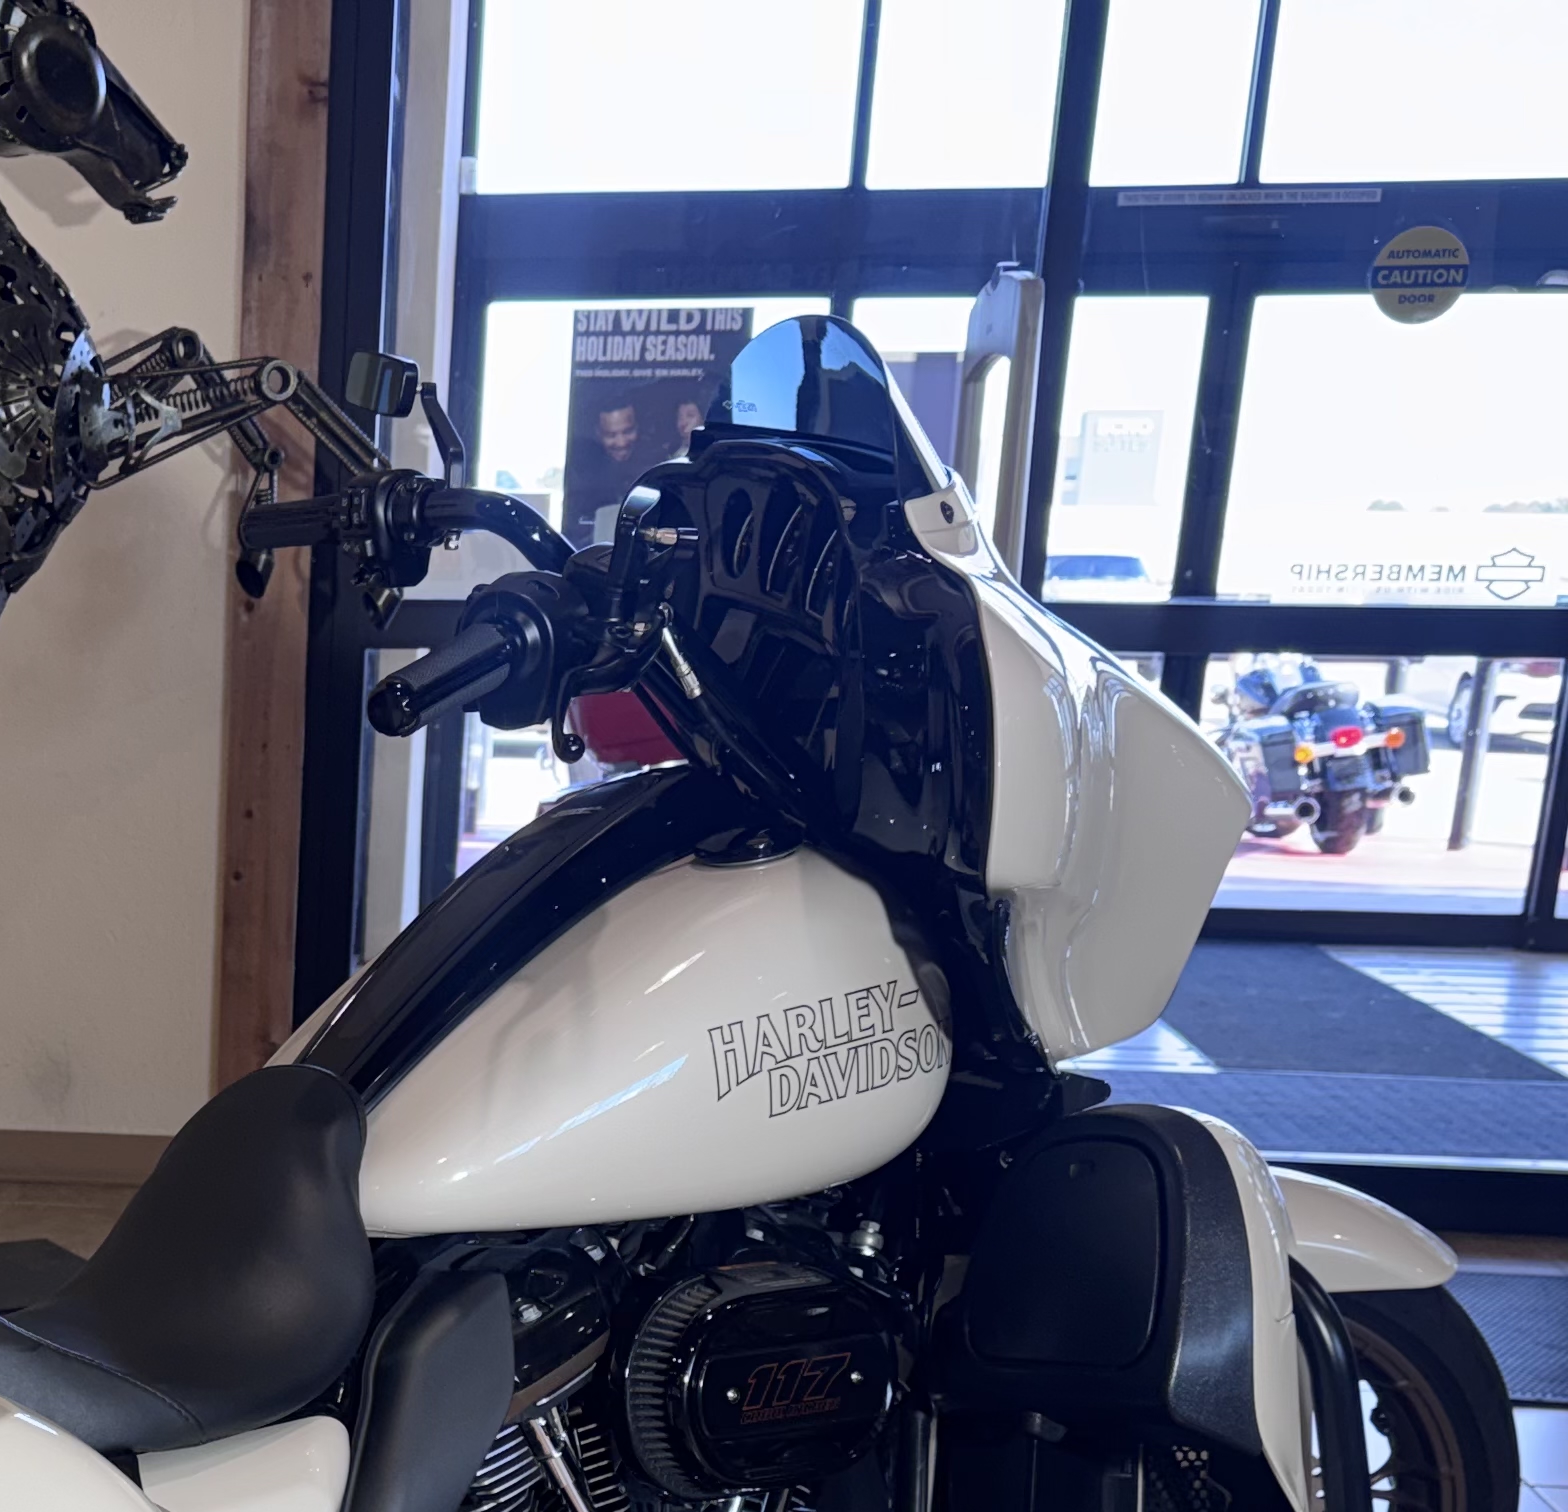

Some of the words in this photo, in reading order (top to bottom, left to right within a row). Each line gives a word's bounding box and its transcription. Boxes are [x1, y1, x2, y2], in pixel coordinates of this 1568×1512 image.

[1387, 248, 1460, 259] AUTOMATIC
[1377, 268, 1464, 285] CAUTION
[1398, 294, 1435, 304] DOOR
[576, 310, 615, 331] STAY
[619, 309, 702, 331] WILD
[705, 308, 743, 331] THIS
[575, 335, 644, 361] HOLIDAY
[644, 335, 715, 361] SEASON.
[707, 980, 920, 1101] HARLEY-
[742, 1352, 851, 1410] 117
